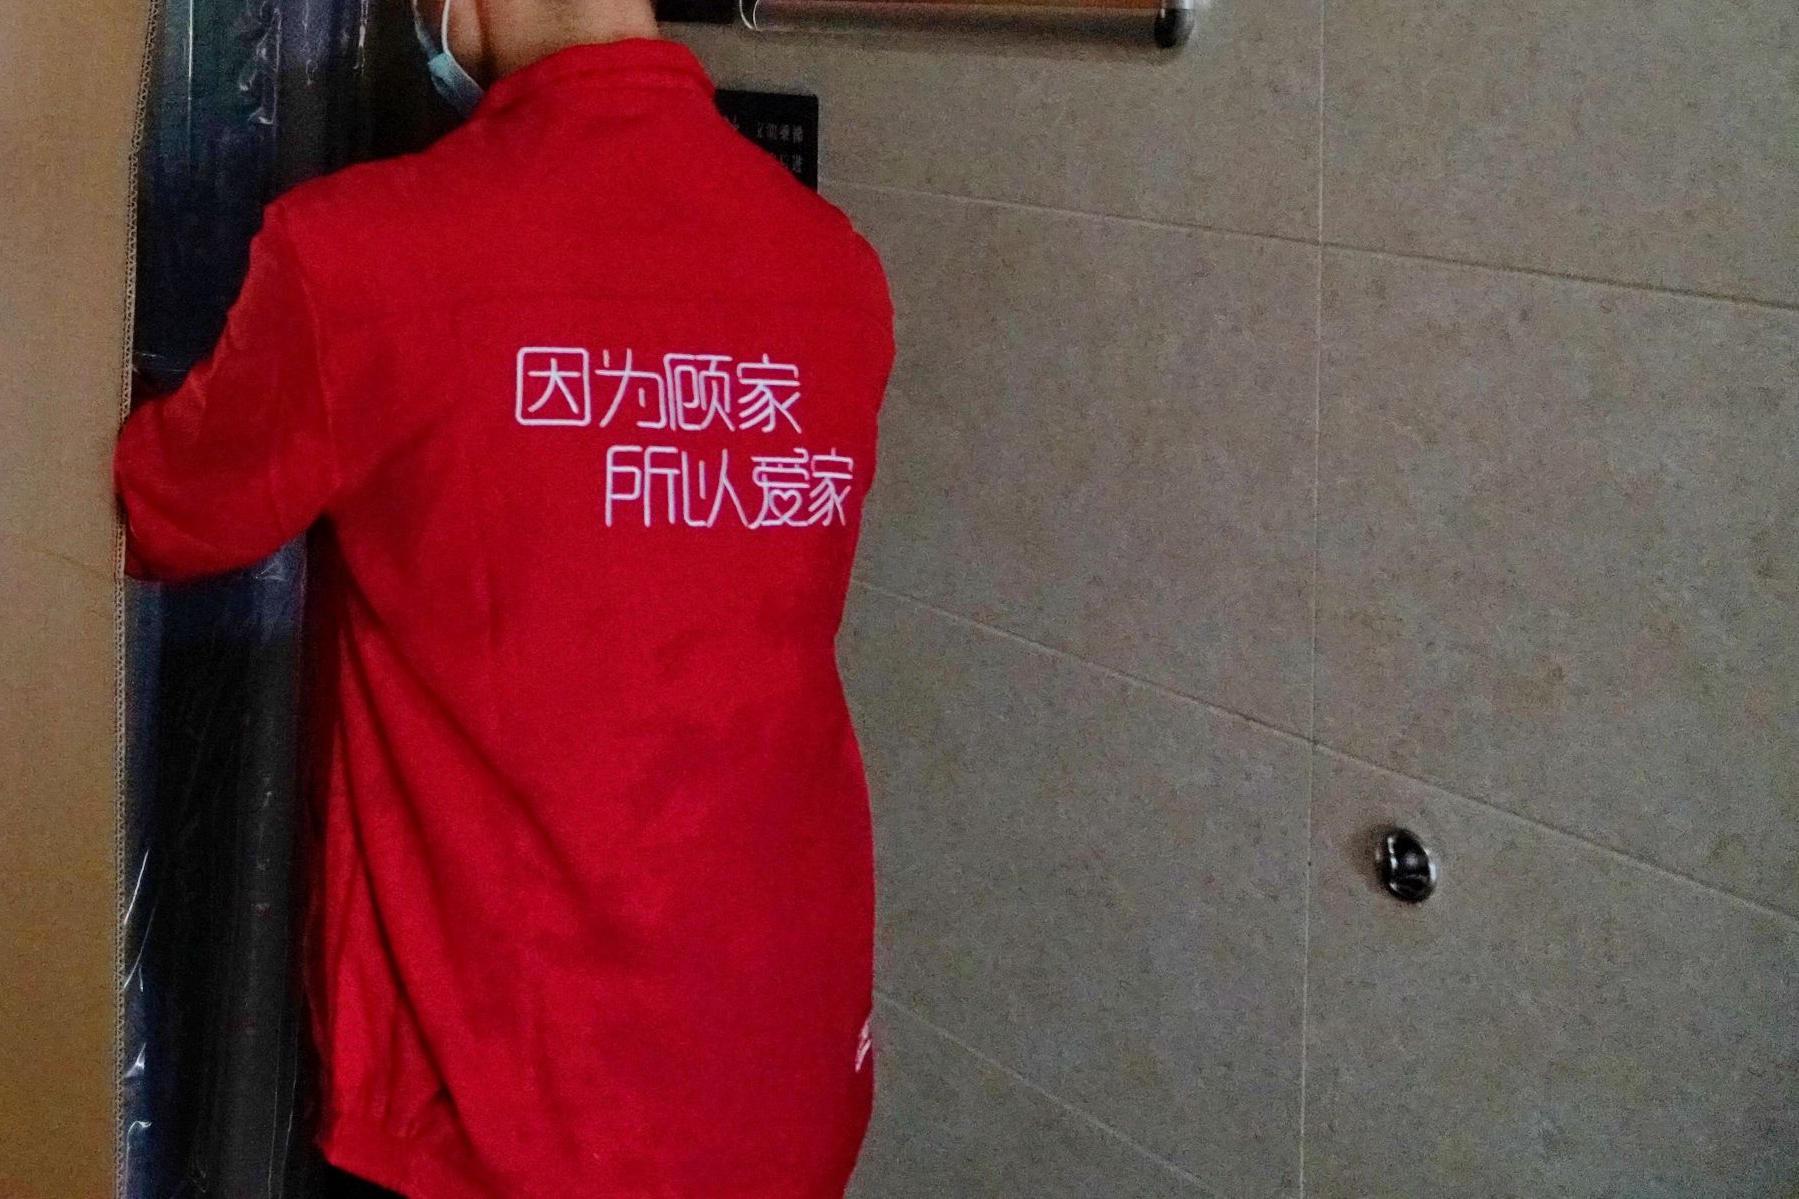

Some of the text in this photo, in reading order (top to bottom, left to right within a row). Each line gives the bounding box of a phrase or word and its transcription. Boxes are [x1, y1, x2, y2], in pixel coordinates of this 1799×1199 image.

[515, 345, 803, 434] 因为顾家
[605, 445, 855, 530] 所以爱家
